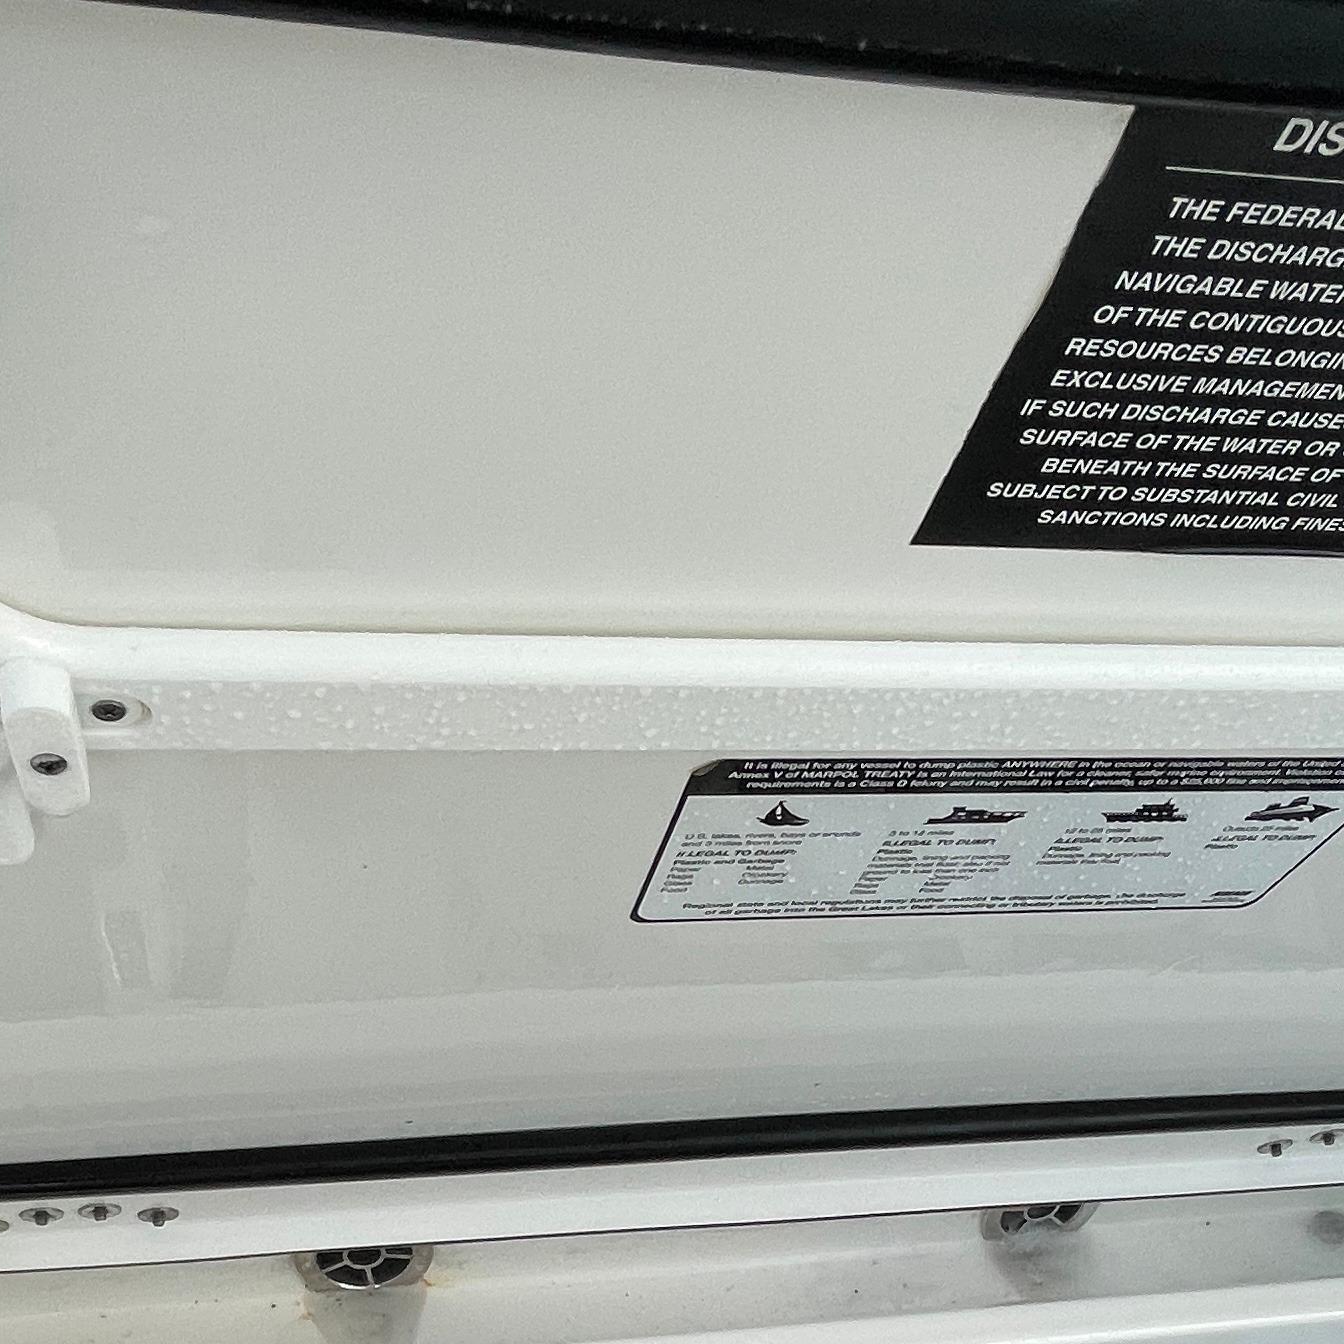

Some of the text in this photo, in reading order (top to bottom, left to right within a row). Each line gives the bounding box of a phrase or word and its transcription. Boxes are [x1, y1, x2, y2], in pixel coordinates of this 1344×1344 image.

[1168, 196, 1226, 222] THE
[1151, 234, 1207, 259] THE
[1113, 270, 1270, 299] NAVIGABLE
[1093, 304, 1134, 325] OF
[1134, 306, 1188, 328] THE
[1064, 337, 1225, 364] RESOURCES
[1049, 368, 1193, 393] EXCLUSIVE
[1019, 398, 1048, 416] IF
[1047, 399, 1120, 420] SUCH
[1120, 403, 1266, 426] DISCHARGE
[1019, 428, 1134, 449] SURFACE
[1135, 432, 1173, 450] OF
[1173, 434, 1222, 452] THE
[1221, 436, 1303, 456] WATER
[1303, 440, 1341, 457] OR
[1040, 457, 1153, 477] BENEATH
[1154, 461, 1202, 478] THE
[1201, 463, 1311, 482] SURFACE
[986, 481, 1097, 501] SUBJECT
[1097, 485, 1128, 501] TO
[1130, 486, 1279, 507] SUBSTANTIAL
[1285, 491, 1339, 508] CIVIL
[1036, 508, 1169, 527] SANCTIONS
[1169, 513, 1291, 532] INCLUDING
[864, 770, 916, 778] TREATY
[1000, 760, 1079, 769] ANYWHERE
